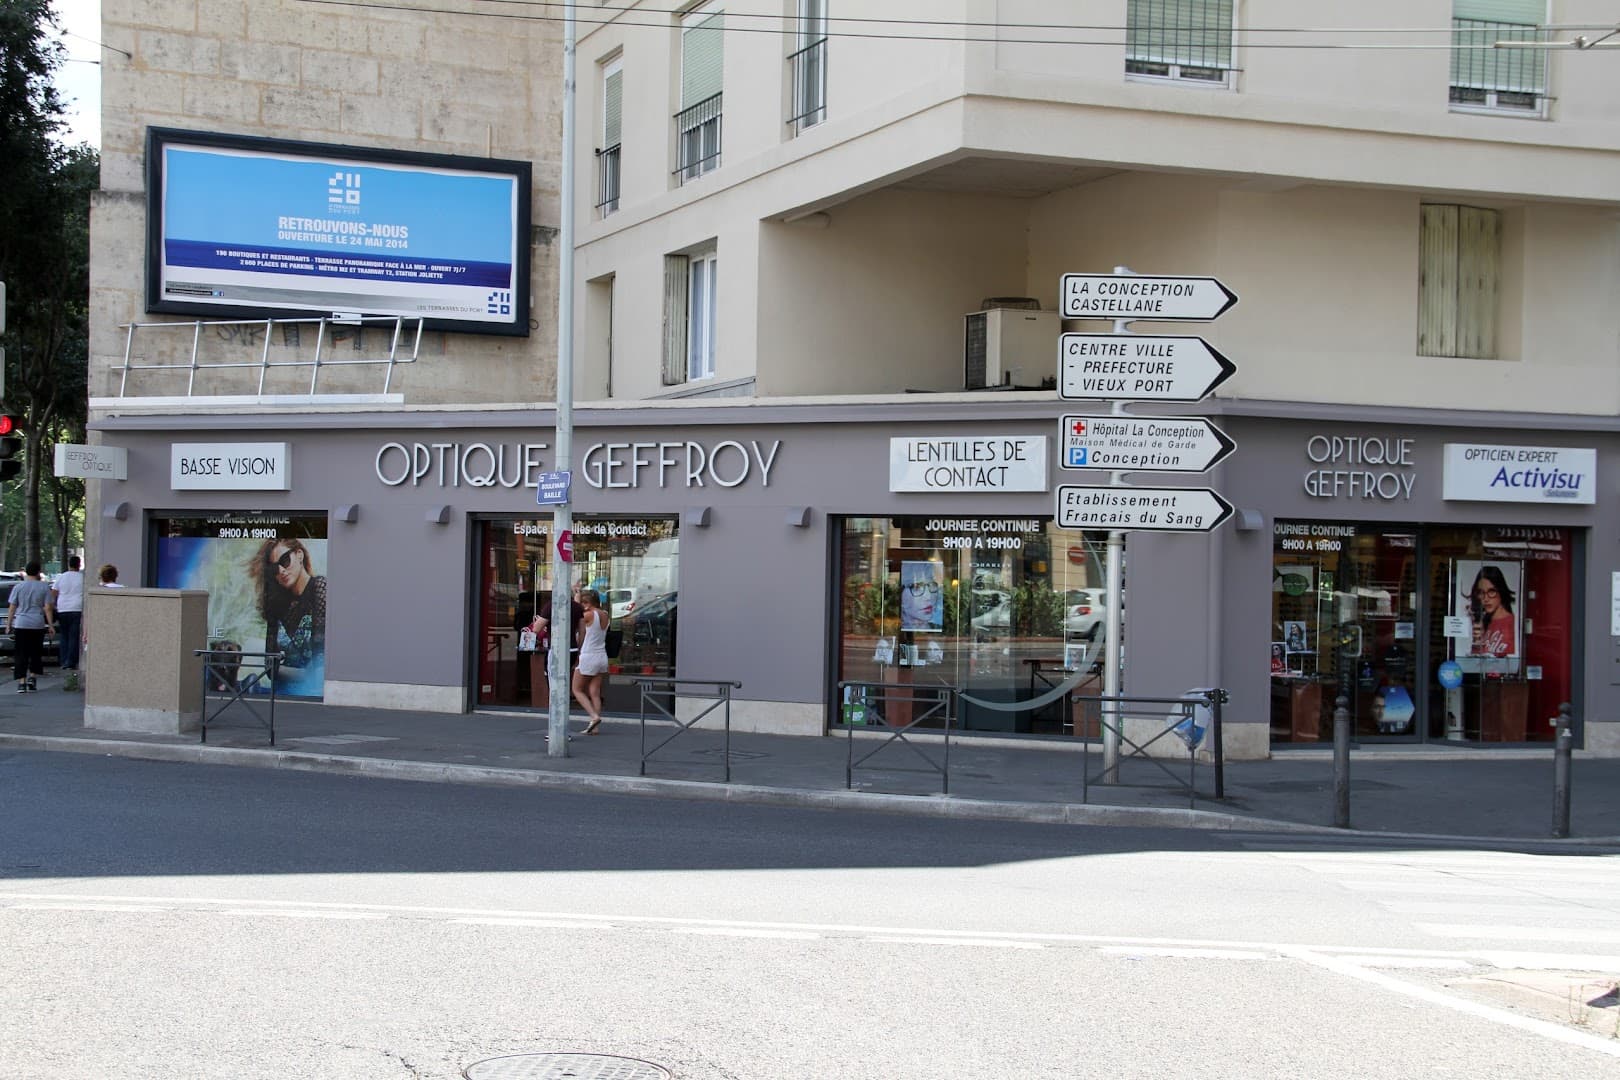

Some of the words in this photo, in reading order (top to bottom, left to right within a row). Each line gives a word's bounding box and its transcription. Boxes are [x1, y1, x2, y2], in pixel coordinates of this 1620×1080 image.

[279, 216, 409, 238] RETROUVONS-NOUS
[279, 230, 334, 244] OUVERTURE
[336, 235, 348, 244] LE
[350, 236, 362, 246] 24
[365, 237, 383, 247] MAI
[385, 239, 408, 249] 2014
[229, 251, 260, 259] BOUTIQUES
[270, 254, 310, 262] RESTAURANTS
[314, 257, 343, 265] TERRASSE
[344, 259, 384, 268] PANORAMIQUE
[257, 260, 279, 268] PLACES
[289, 262, 314, 270] PARKING
[357, 267, 385, 275] TRAMWAY
[1072, 282, 1089, 294] LA
[1098, 282, 1194, 297] CONCEPTION
[1071, 298, 1163, 312] CASTELLANE
[1069, 343, 1127, 356] CENTRE
[1136, 344, 1174, 356] VILLE
[1083, 361, 1174, 374] PREFECTURE
[1083, 378, 1126, 391] VIEUX
[1135, 379, 1173, 392] PORT
[1092, 423, 1128, 438] Hôpital
[1132, 424, 1143, 436] La
[1148, 424, 1204, 439] Conception
[908, 441, 996, 461] LENTILLES
[1004, 441, 1026, 461] DE
[1070, 438, 1104, 446] Maison
[1151, 440, 1162, 448] de
[1168, 440, 1196, 449] Garde
[1307, 435, 1415, 465] OPTIQUE
[1092, 451, 1180, 467] Conception
[1465, 448, 1514, 461] OPTICIEN
[1517, 451, 1558, 463] EXPERT
[181, 457, 222, 475] BASSE
[228, 457, 275, 475] VISION
[375, 442, 547, 488] OPTIQUE
[582, 440, 781, 488] GEFFROY
[924, 466, 1009, 487] CONTACT
[1490, 465, 1581, 489] Activisu
[1304, 470, 1416, 499] GEFFROY
[1066, 492, 1176, 507] Etablissement
[925, 520, 978, 532] JOURNEE
[981, 520, 1040, 532] CONTINUE
[1066, 510, 1131, 524] Français
[1140, 512, 1157, 523] du
[1165, 512, 1203, 528] Sang
[220, 528, 241, 538] 9H00
[243, 529, 249, 538] A
[251, 528, 276, 538] 19H00
[514, 523, 548, 536] Espace
[551, 523, 590, 534] Lilles
[594, 523, 606, 535] de
[608, 523, 647, 535] Contact
[1274, 524, 1309, 535] OURNEE
[1311, 526, 1355, 536] CONTINUE
[943, 537, 972, 549] 9H00
[975, 537, 983, 548] A
[986, 537, 1021, 549] 19H00
[1282, 539, 1305, 550] 9H00
[1306, 540, 1313, 550] A
[1315, 540, 1342, 551] 19H00
